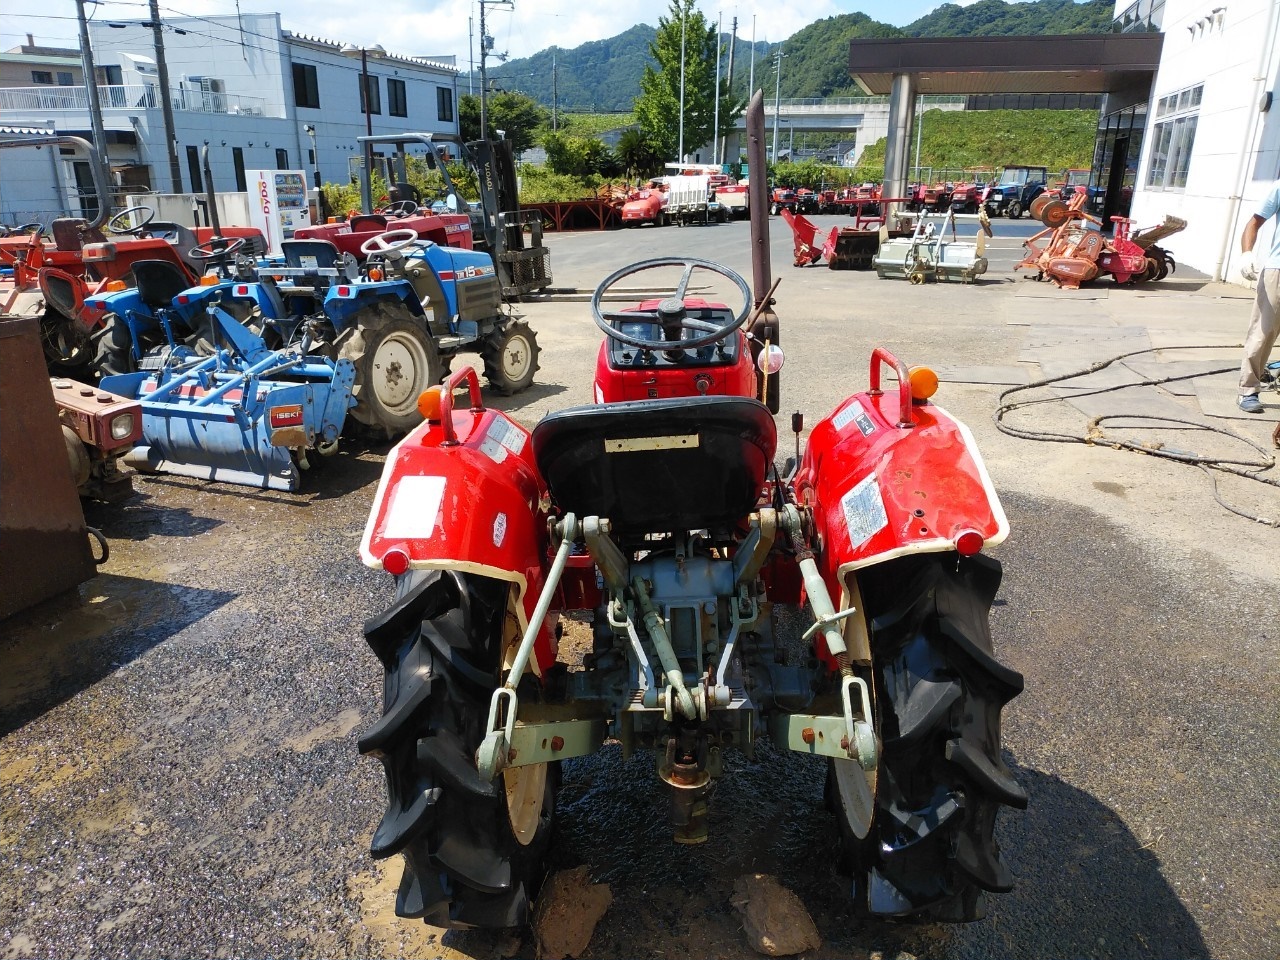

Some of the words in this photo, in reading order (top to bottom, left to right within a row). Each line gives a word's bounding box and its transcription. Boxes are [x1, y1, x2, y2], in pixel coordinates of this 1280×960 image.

[484, 161, 493, 191] TOYOTA
[261, 181, 271, 214] DyDo
[276, 411, 299, 419] ISEKI
